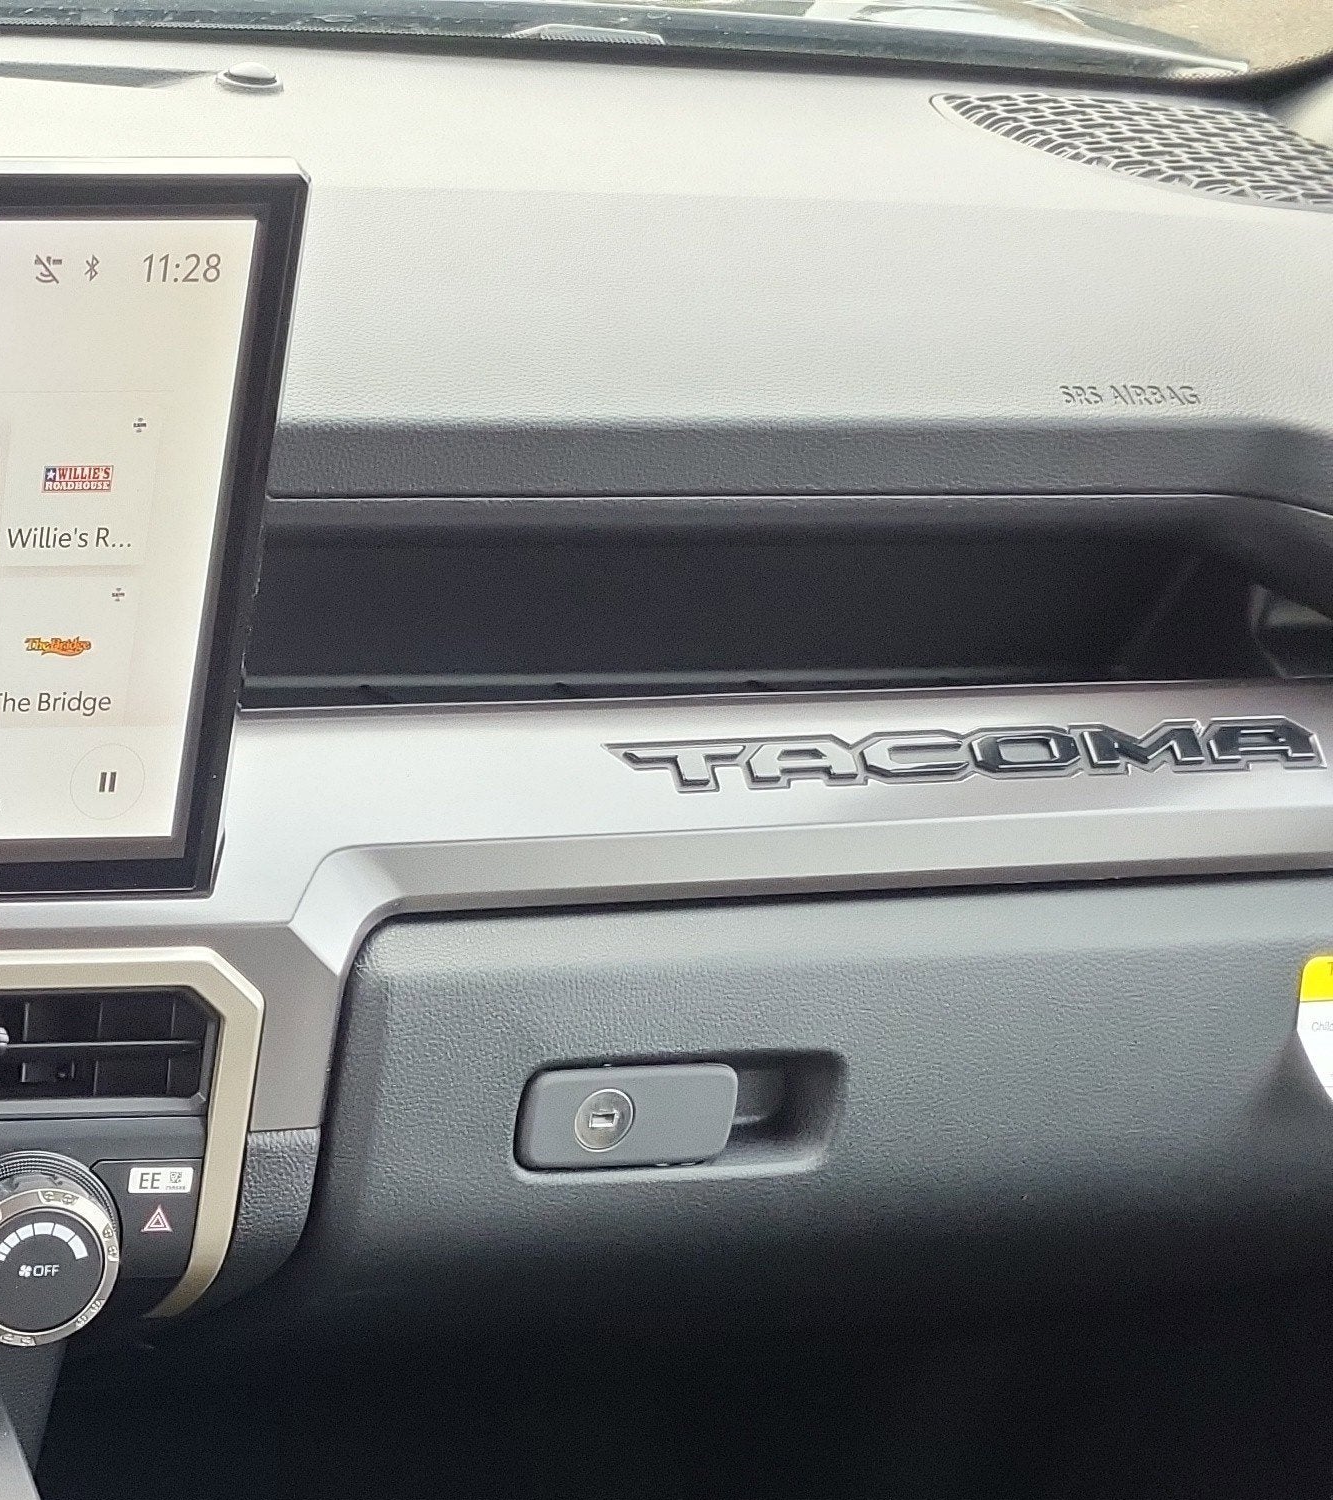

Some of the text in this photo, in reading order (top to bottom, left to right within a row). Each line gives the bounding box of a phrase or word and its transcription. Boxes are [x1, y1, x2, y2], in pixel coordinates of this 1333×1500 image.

[140, 252, 222, 284] 11:28
[1059, 384, 1201, 405] SRS AIRBAG
[57, 467, 111, 480] WILLIE'S
[44, 481, 110, 492] ROADHOUSE
[8, 526, 88, 549] Willie's
[37, 692, 112, 717] Bridge
[600, 716, 1327, 793] TACOMA
[139, 1172, 161, 1189] EE
[33, 1263, 60, 1277] OFF
